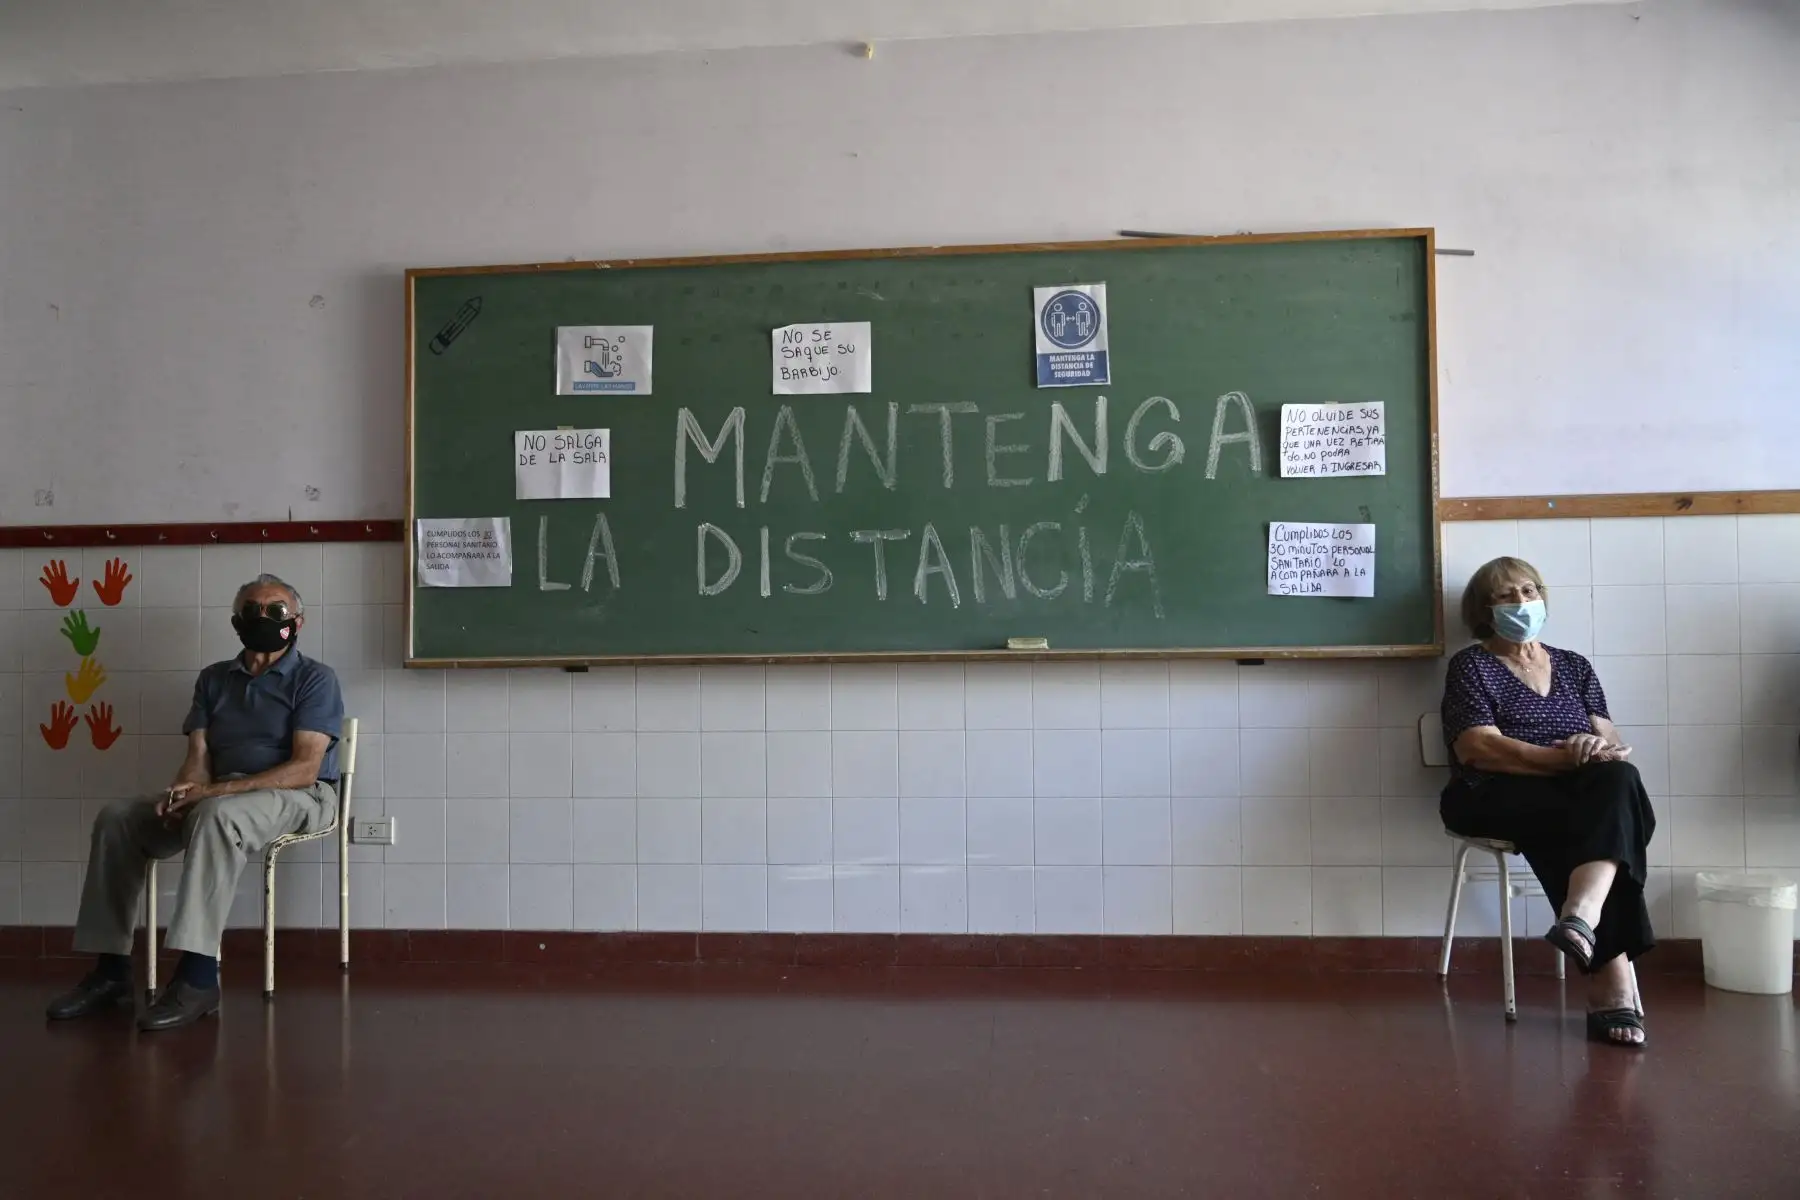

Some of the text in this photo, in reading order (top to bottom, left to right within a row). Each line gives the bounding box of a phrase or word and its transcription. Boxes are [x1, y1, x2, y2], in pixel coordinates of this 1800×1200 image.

[783, 329, 831, 344] NO SE
[838, 344, 855, 354] SU
[1287, 408, 1379, 423] NO OLVIDE SUS
[524, 433, 602, 451] NO SALGA
[1304, 440, 1321, 449] UNA
[674, 391, 1262, 508] MANTENGA
[520, 452, 606, 466] DE LA SALA
[1287, 461, 1381, 475] VOLVER A INGRESAR
[1331, 528, 1353, 540] LOS
[538, 512, 621, 593] LA
[1270, 543, 1285, 555] 30
[1333, 557, 1346, 567] LO
[1354, 568, 1366, 577] LA
